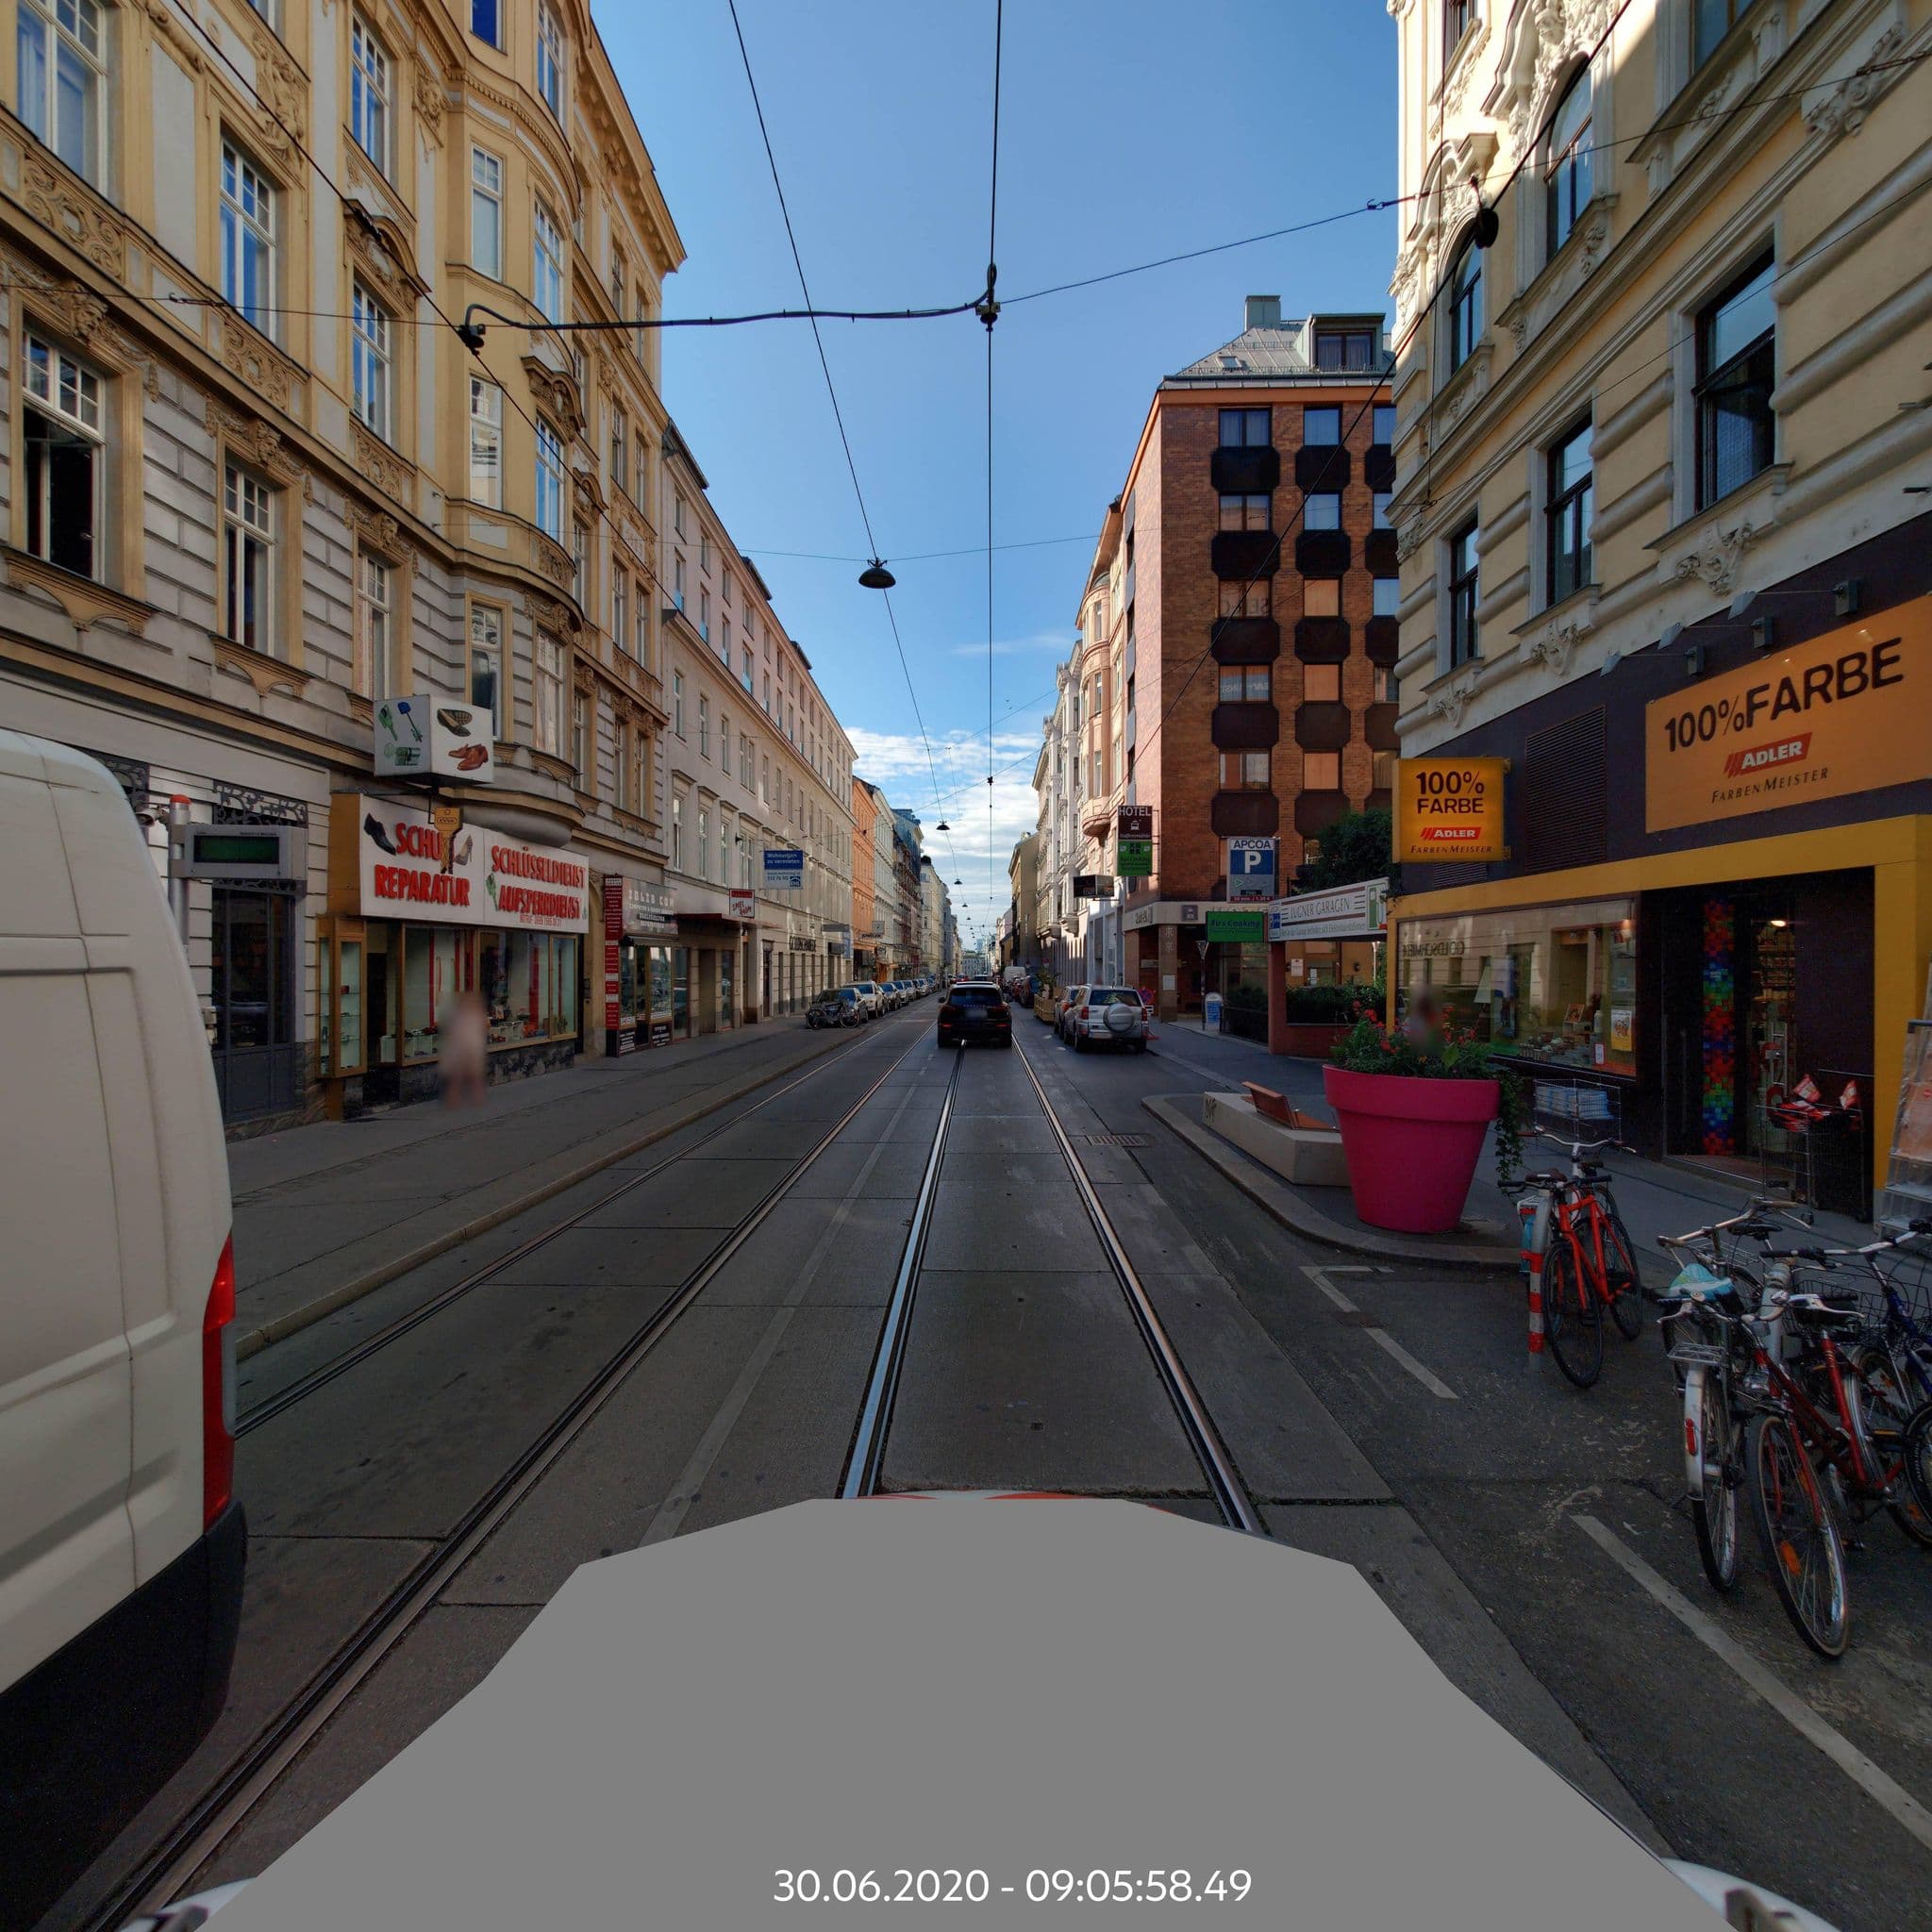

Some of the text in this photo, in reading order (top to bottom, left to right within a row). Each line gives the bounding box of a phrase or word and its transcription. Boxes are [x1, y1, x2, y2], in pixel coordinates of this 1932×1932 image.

[1745, 637, 1904, 728] FARBE
[1740, 741, 1804, 771] ADLER
[1415, 771, 1485, 794] 100%
[1118, 807, 1152, 817] HOTEL
[1417, 798, 1485, 814] FARBE
[395, 823, 452, 862] SCHU
[1233, 840, 1272, 849] APCOA
[1433, 828, 1476, 839] ADLER
[491, 845, 586, 890] SCHLÜSSELDIENST
[1244, 850, 1262, 874] P
[374, 864, 471, 908] REPARATUR
[497, 885, 581, 920] AUFSPERRDIENST
[1291, 904, 1314, 920] LUGNER
[1315, 897, 1351, 916] GARAGEN
